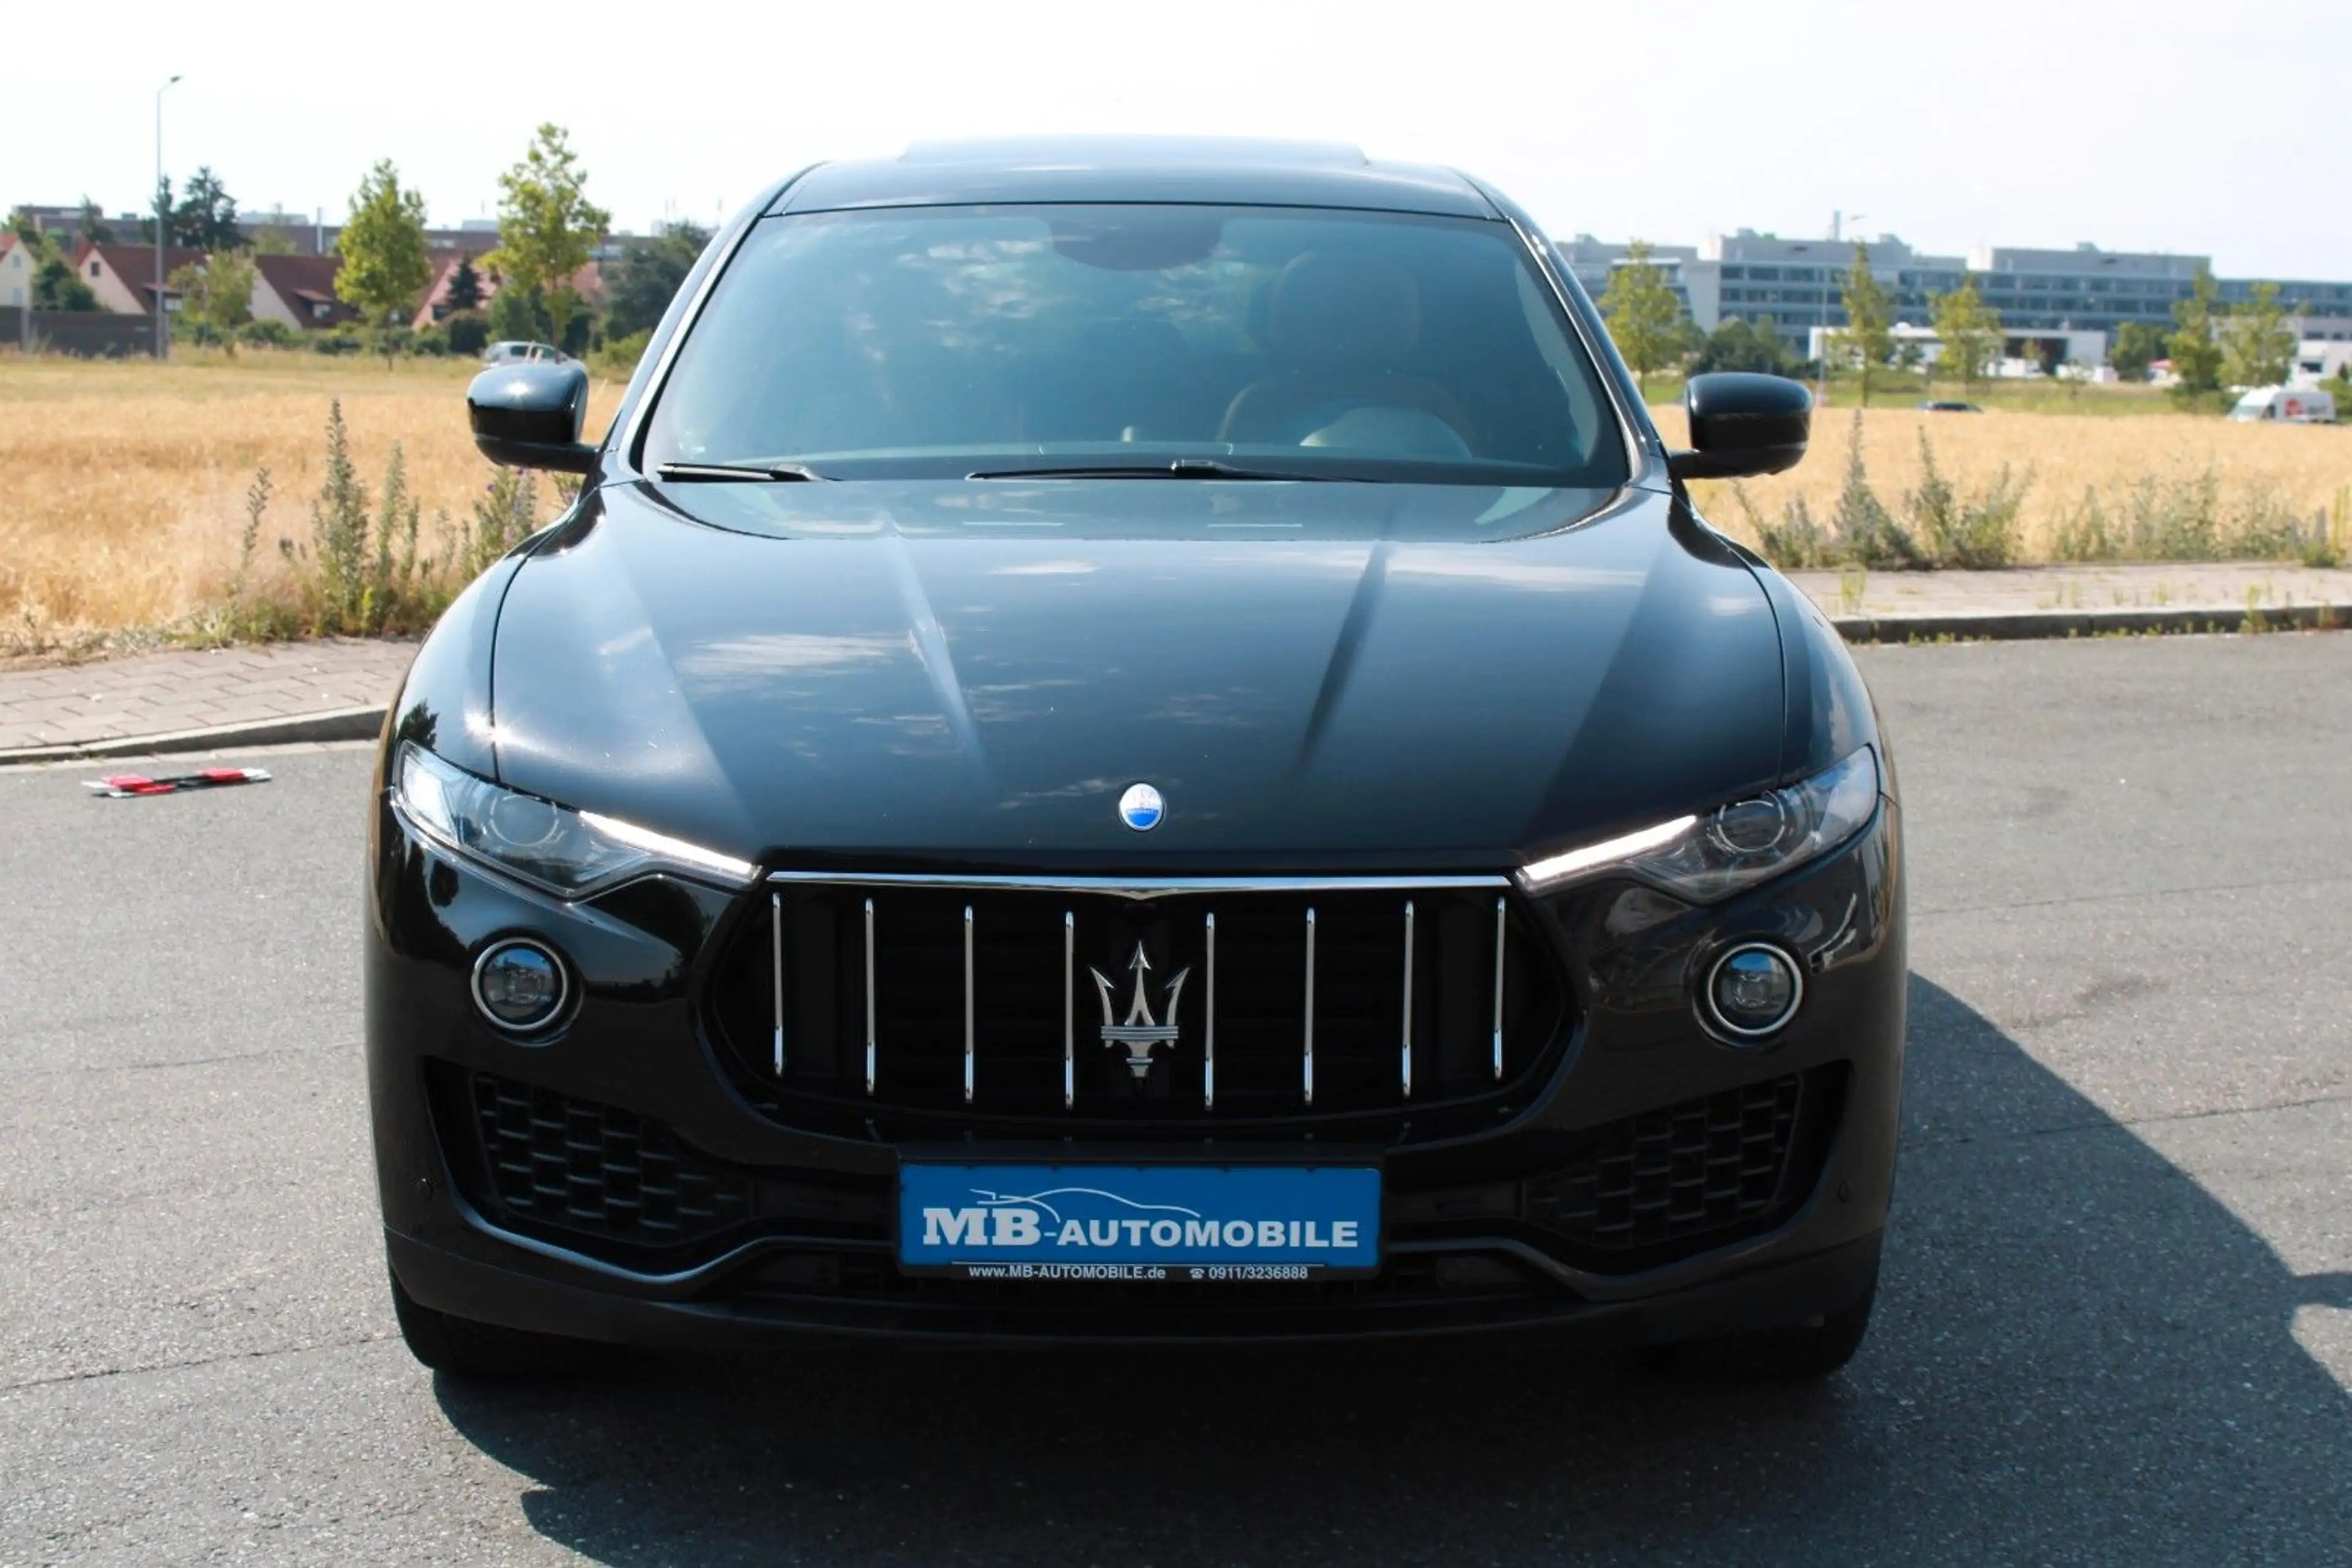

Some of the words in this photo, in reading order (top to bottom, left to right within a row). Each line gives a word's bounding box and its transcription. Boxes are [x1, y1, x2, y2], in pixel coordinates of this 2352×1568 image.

[923, 1208, 1358, 1247] MB-AUTOMOBILE
[968, 1265, 1166, 1280] www.MB-AUTOMOBILE.de
[1208, 1266, 1308, 1280] 0911/3236888
